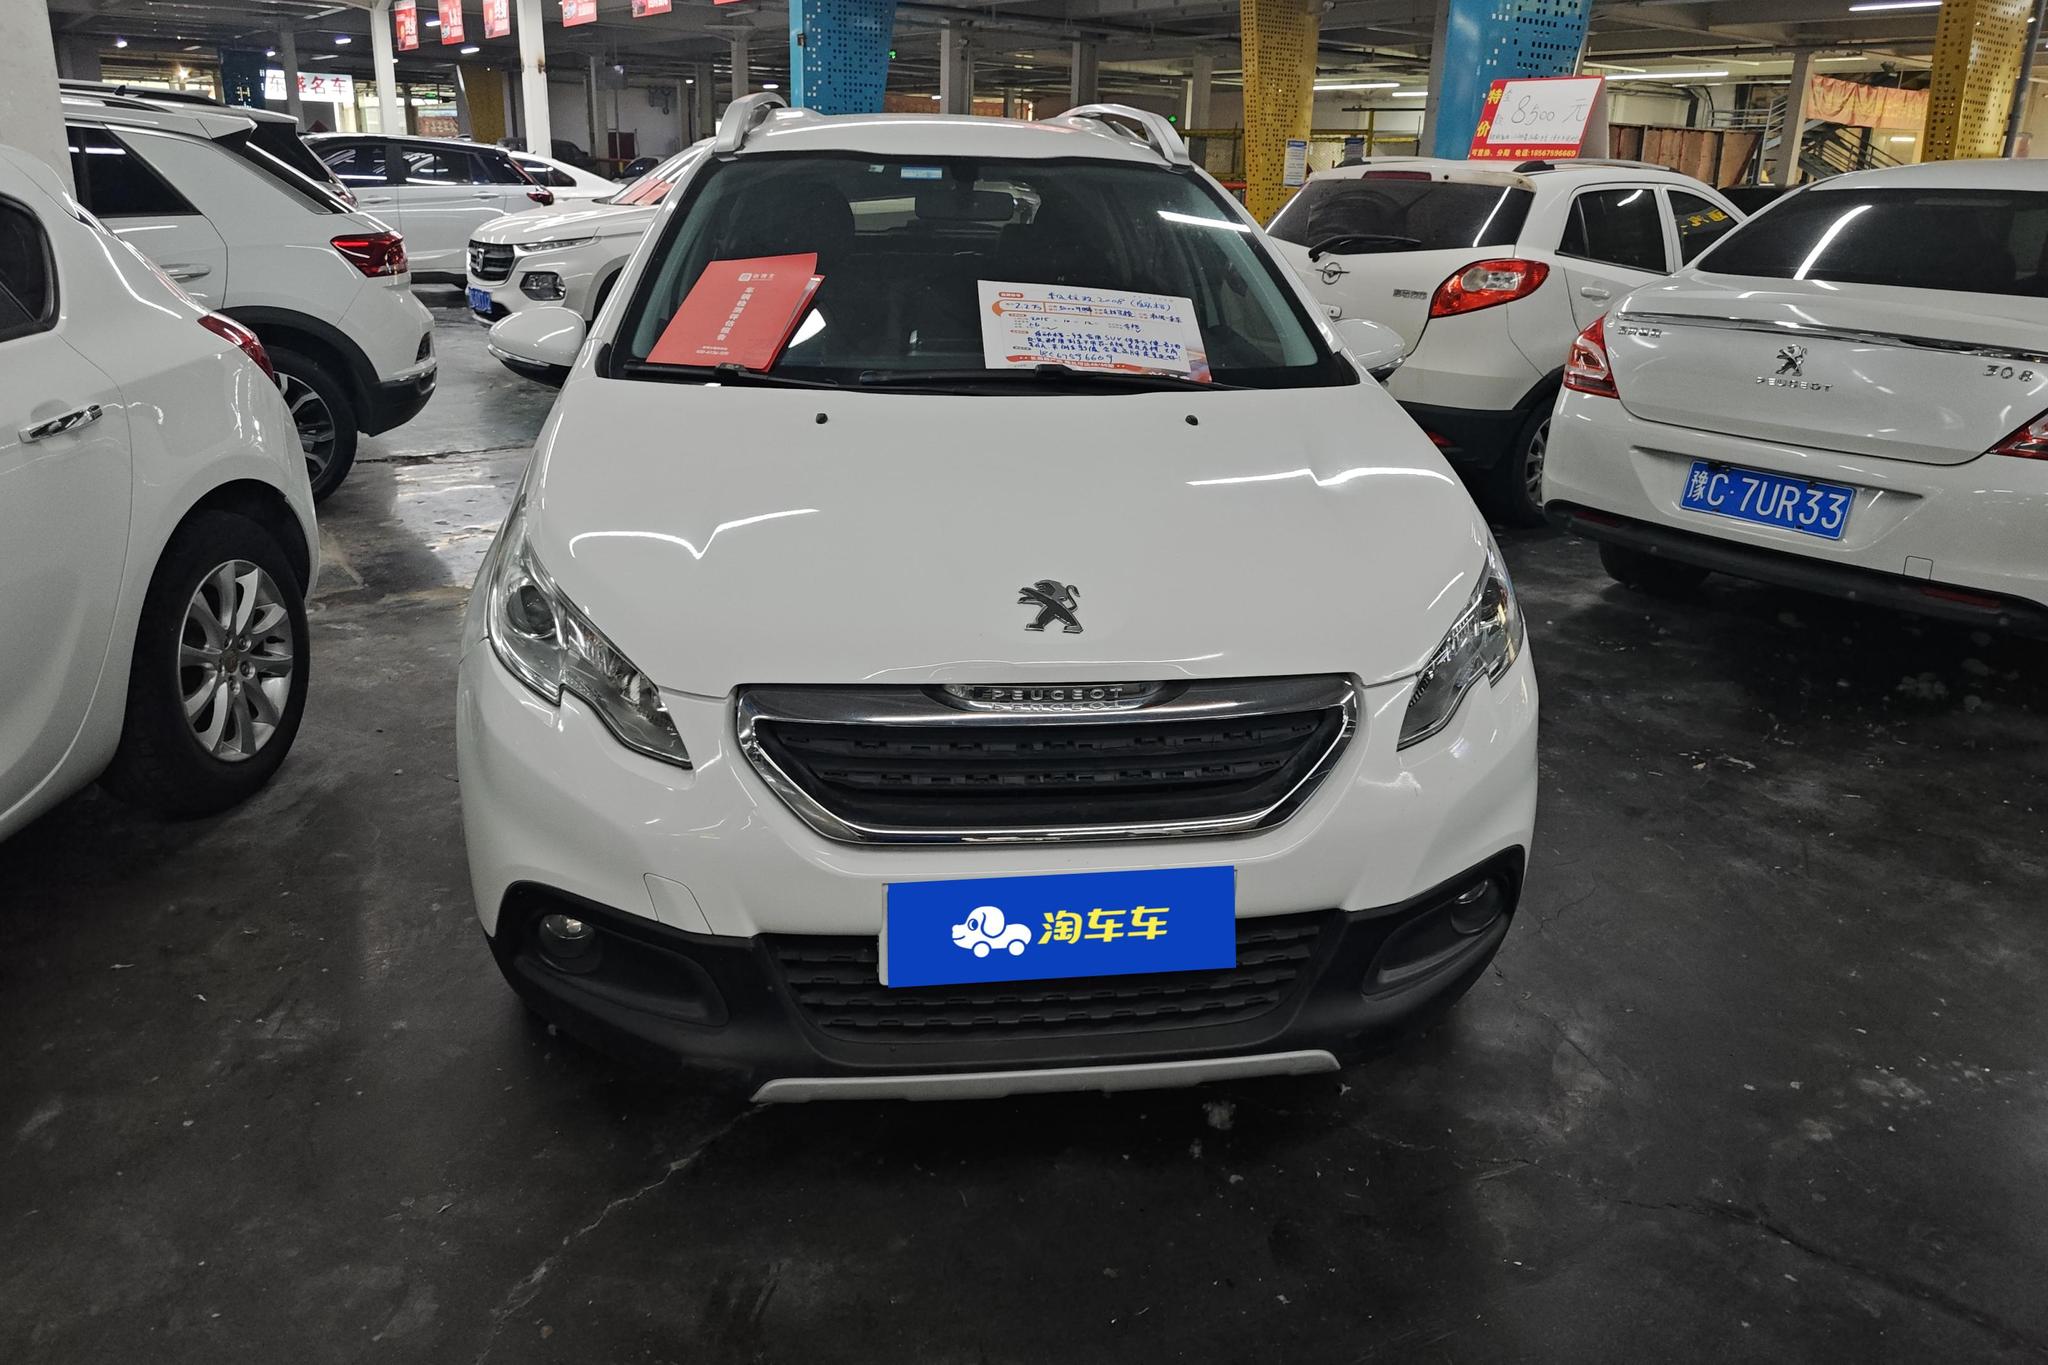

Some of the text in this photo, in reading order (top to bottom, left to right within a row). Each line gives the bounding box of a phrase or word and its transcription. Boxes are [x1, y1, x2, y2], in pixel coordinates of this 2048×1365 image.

[1511, 95, 1555, 126] 8500
[1983, 365, 2034, 382] 308
[991, 688, 1123, 701] PEUGEOT
